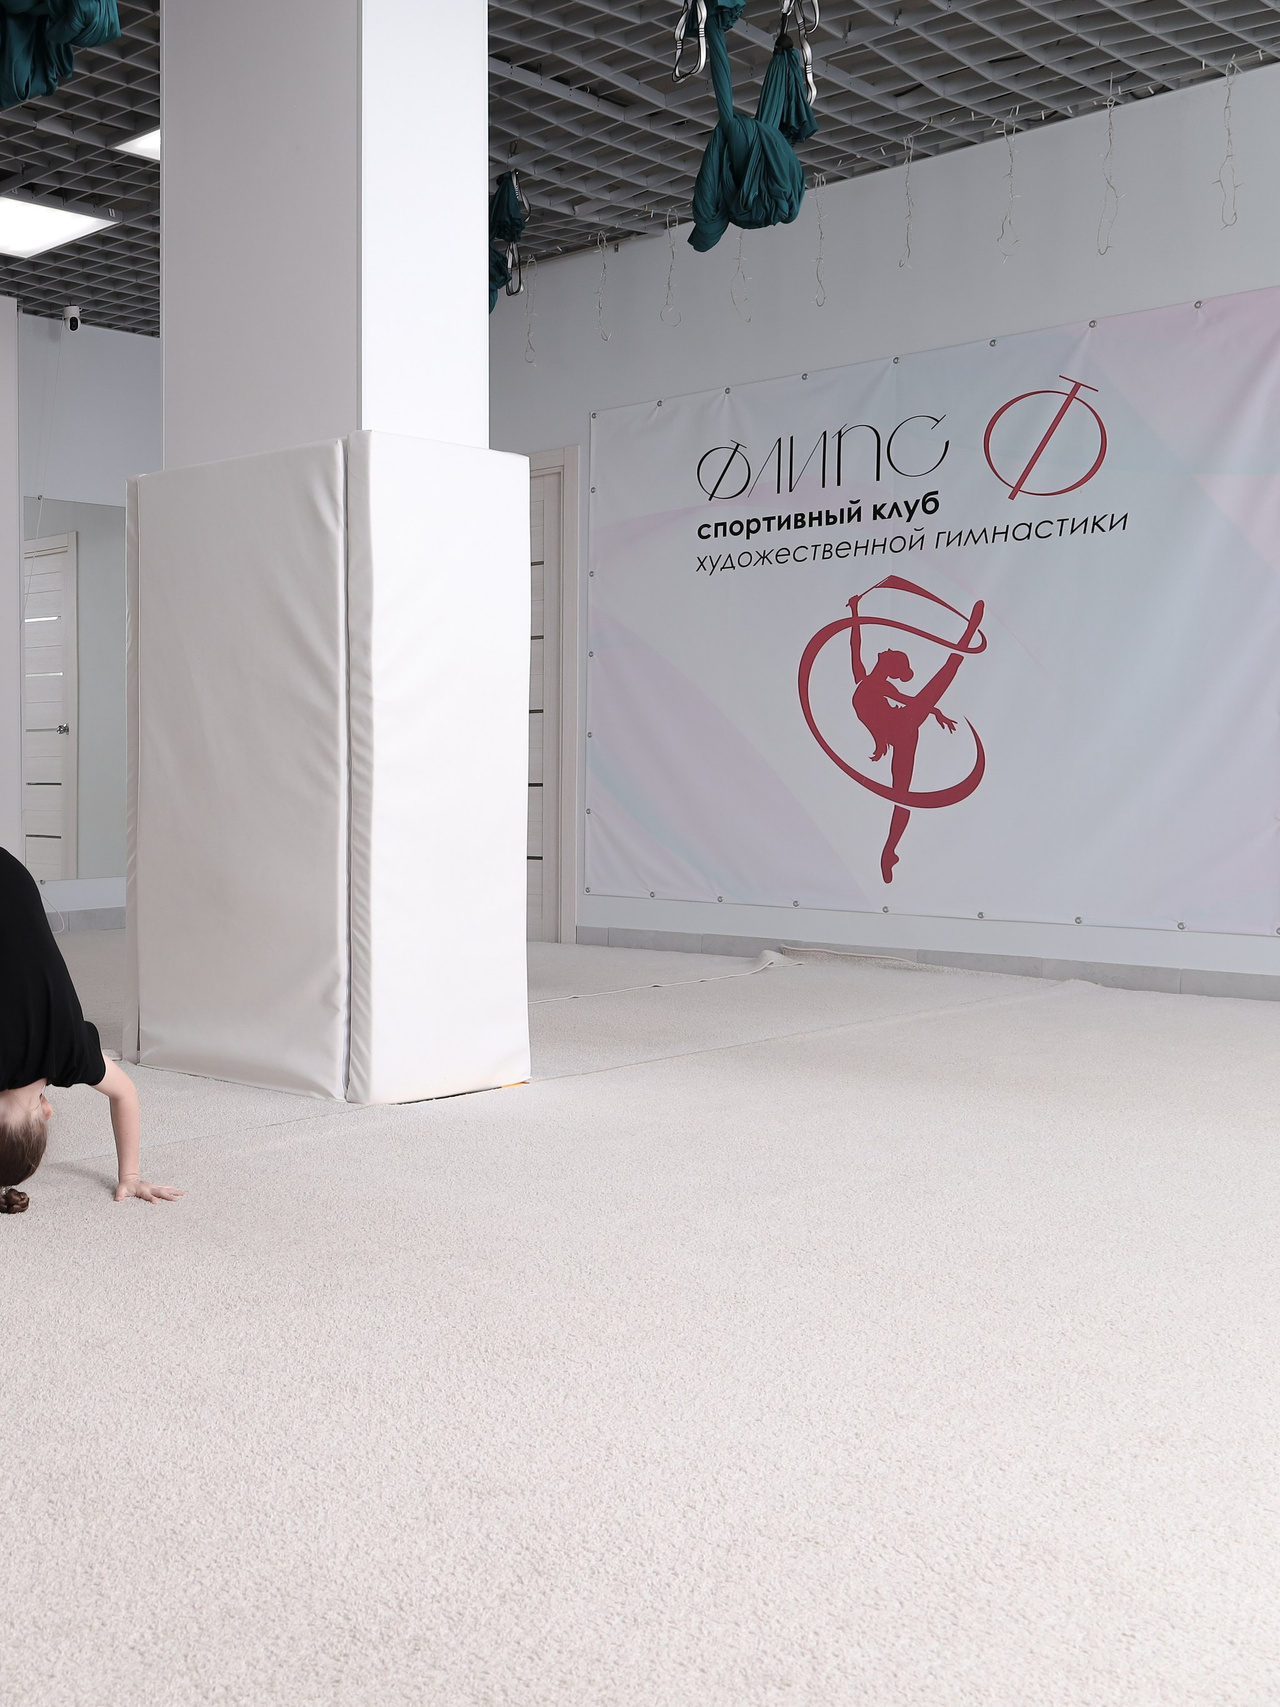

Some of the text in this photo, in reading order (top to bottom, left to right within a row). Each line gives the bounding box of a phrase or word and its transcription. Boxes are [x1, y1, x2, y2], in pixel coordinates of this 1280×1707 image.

[696, 413, 950, 502] ФЛИПС
[695, 512, 1129, 576] художественной гимнастики
[697, 490, 940, 540] спортивный клуб
